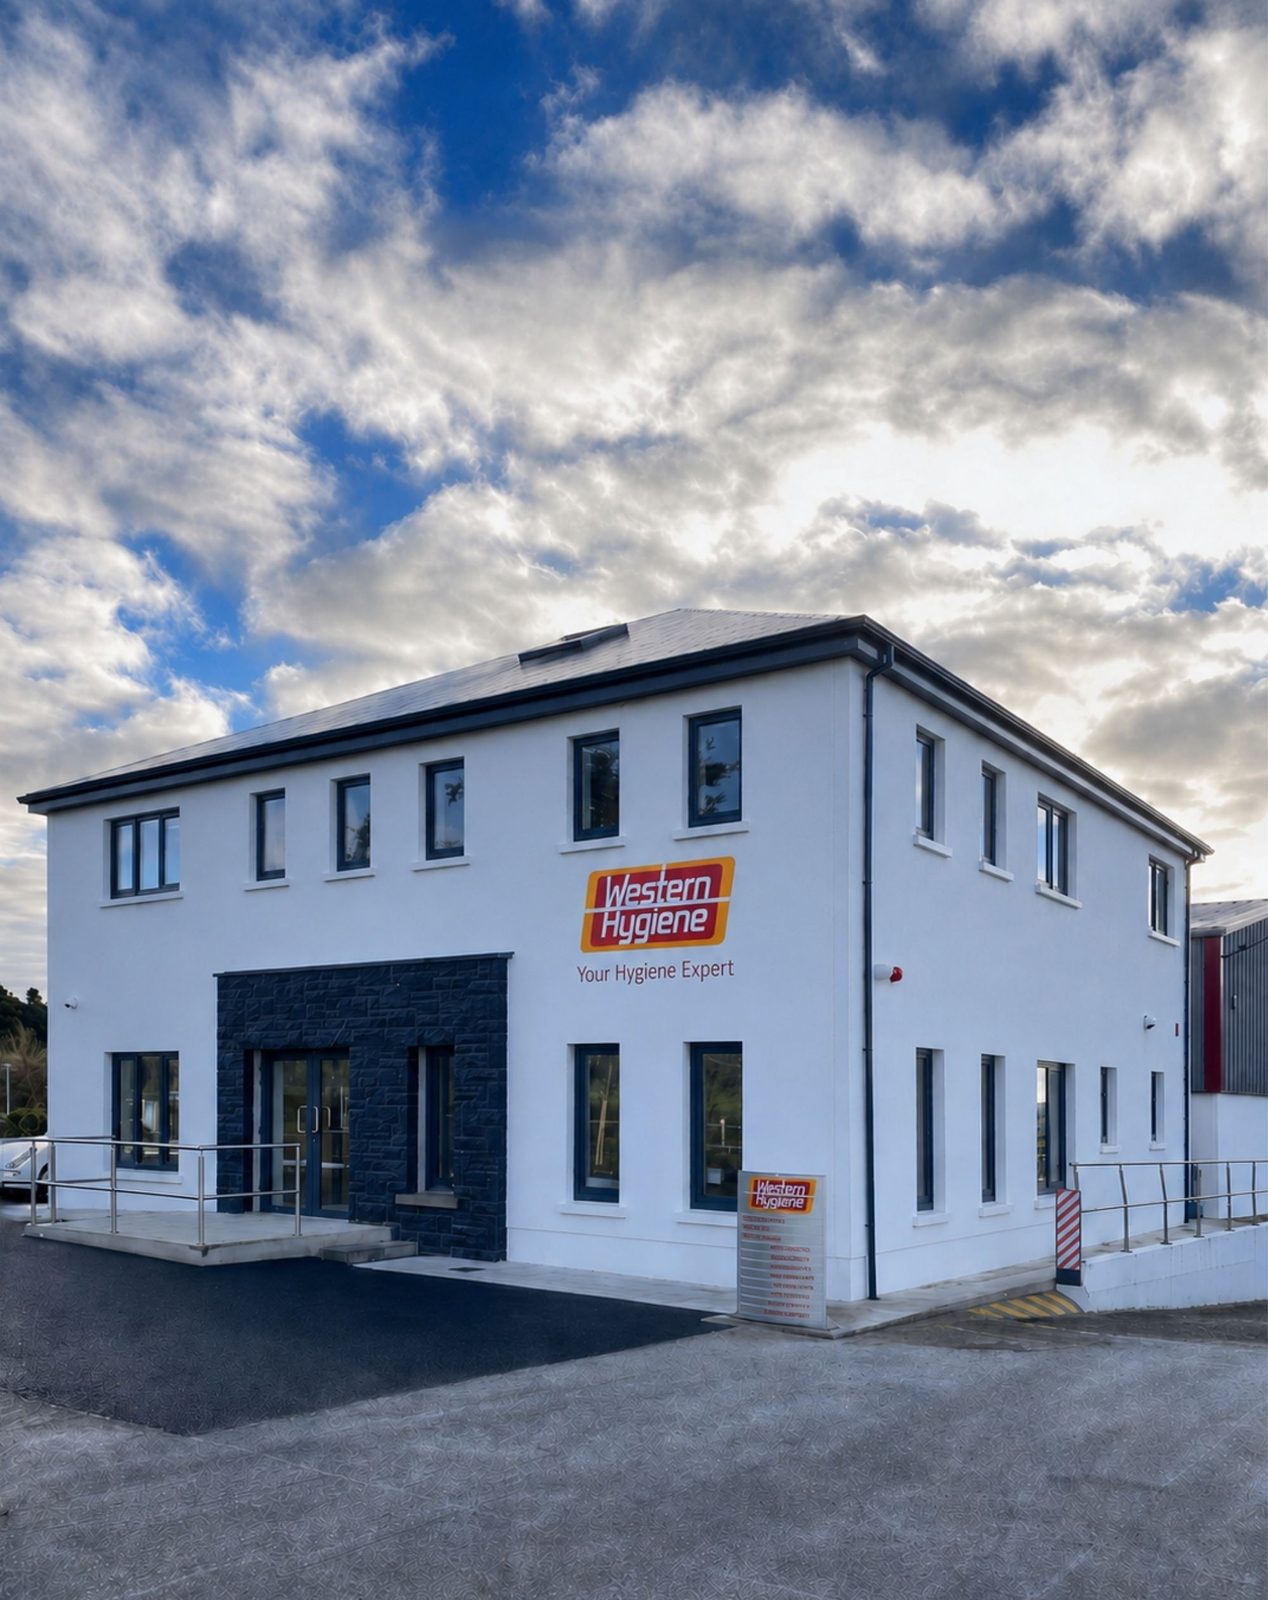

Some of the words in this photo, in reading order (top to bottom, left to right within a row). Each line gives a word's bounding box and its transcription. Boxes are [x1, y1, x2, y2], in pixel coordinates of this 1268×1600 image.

[605, 864, 712, 907] Western
[601, 908, 708, 945] Hygiene
[577, 966, 610, 983] Your
[616, 963, 676, 984] Hygiene
[682, 960, 734, 982] Expert
[757, 1179, 805, 1197] Western
[756, 1194, 804, 1209] Hygiene
